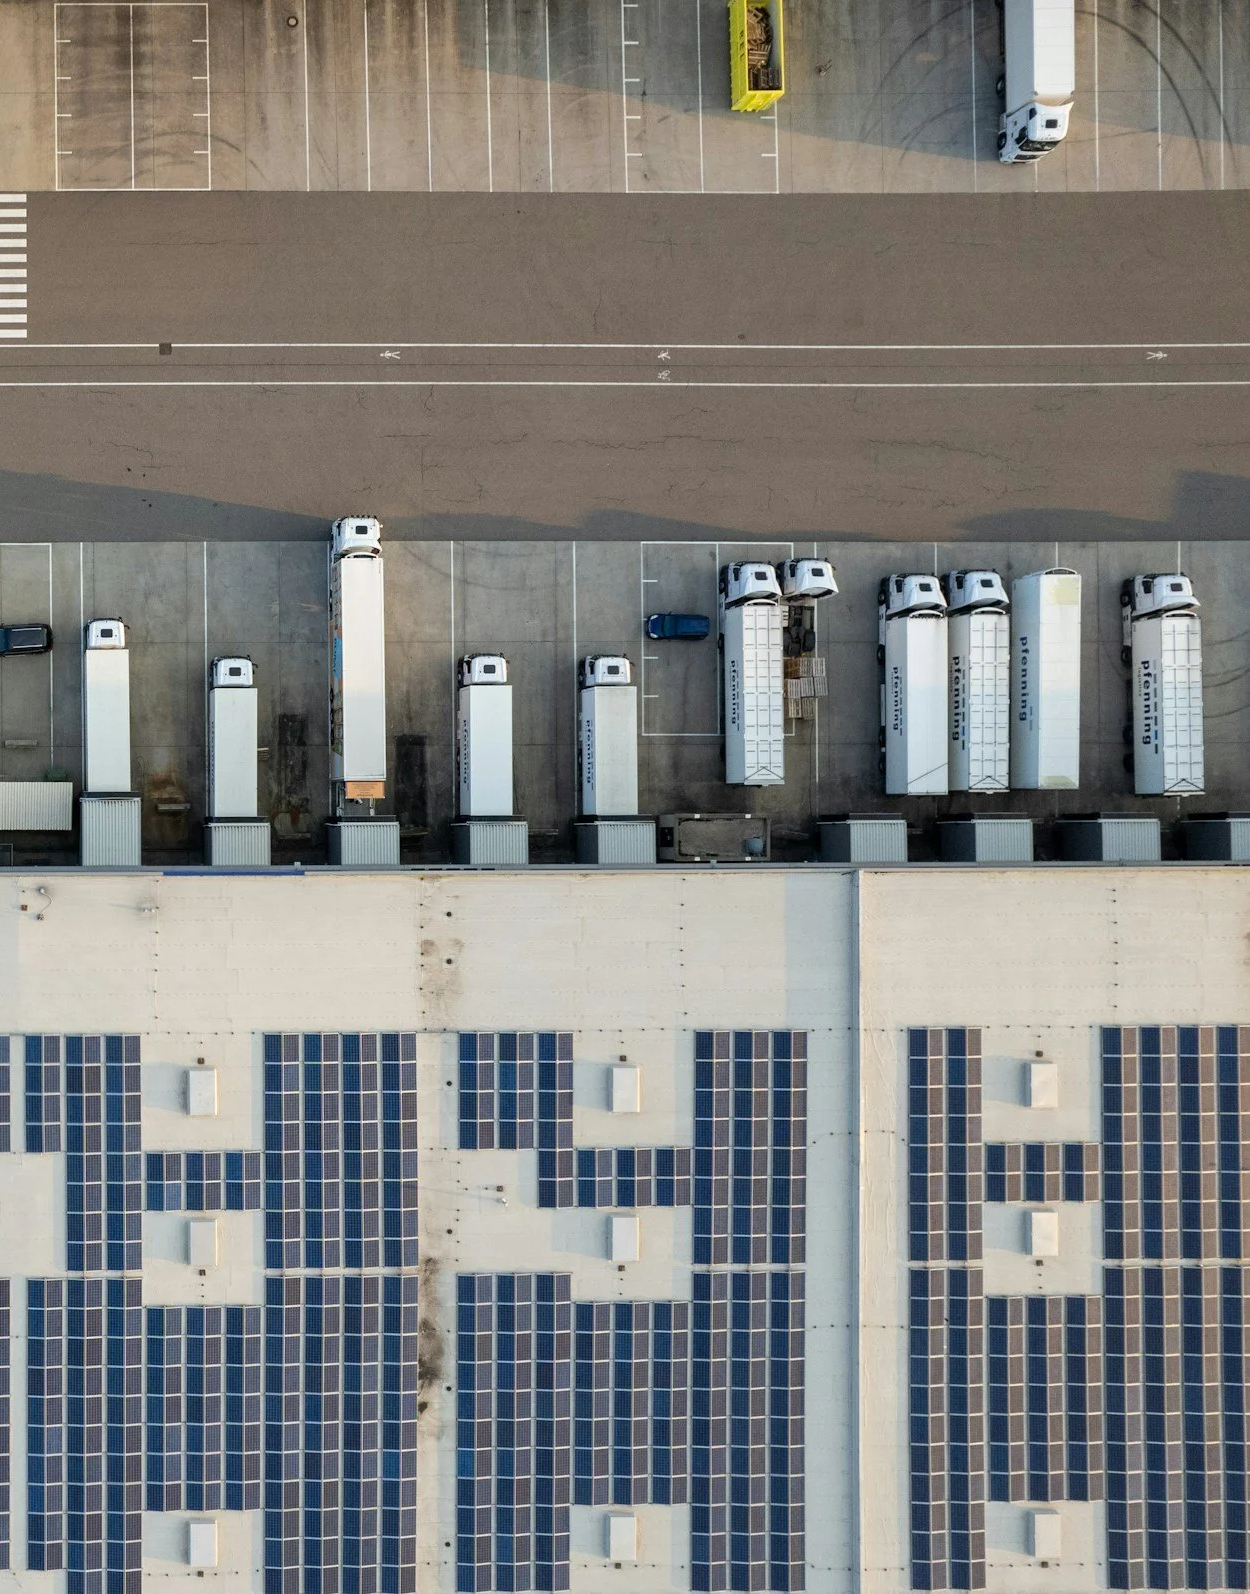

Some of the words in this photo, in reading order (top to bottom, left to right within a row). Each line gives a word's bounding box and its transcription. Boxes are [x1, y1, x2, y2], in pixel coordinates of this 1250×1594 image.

[952, 656, 961, 740] pfenning
[1019, 636, 1029, 721] pfenning
[1141, 660, 1152, 745] pfenning
